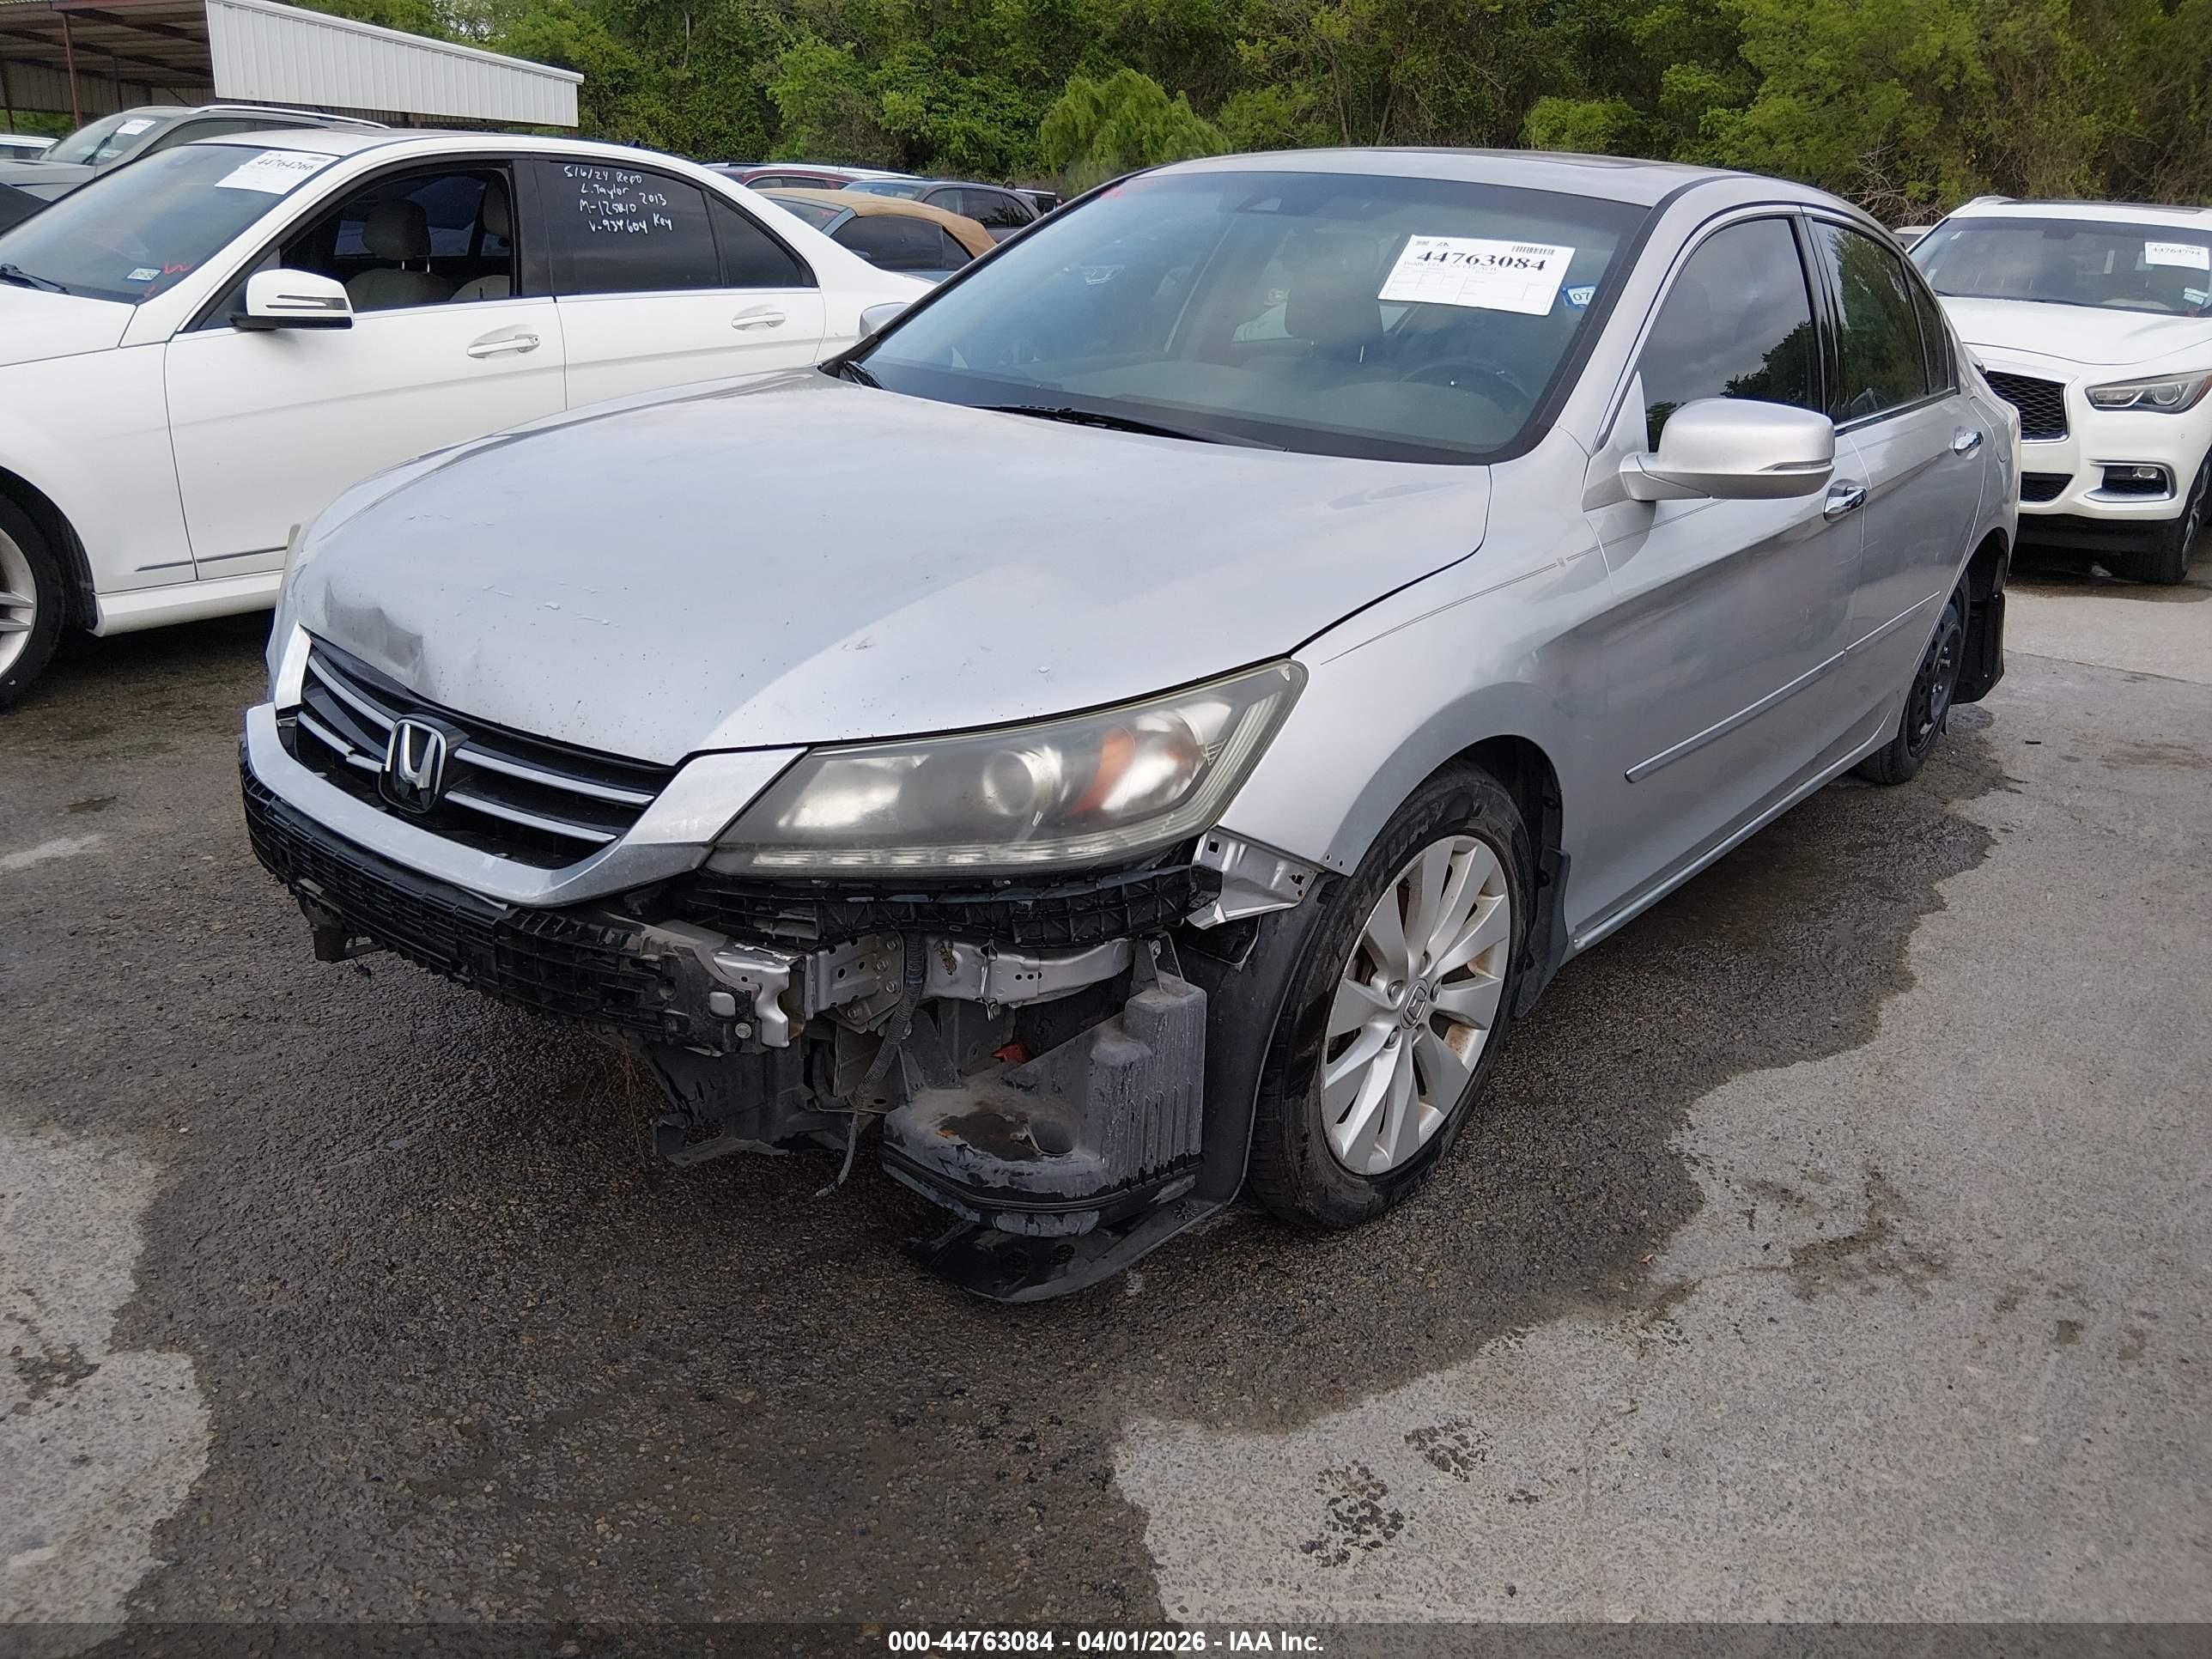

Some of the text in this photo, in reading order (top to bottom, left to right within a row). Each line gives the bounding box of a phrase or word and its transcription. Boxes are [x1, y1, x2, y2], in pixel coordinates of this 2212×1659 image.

[639, 192, 667, 206] 2013
[653, 213, 673, 231] Key
[1417, 250, 1546, 270] 44763084
[1572, 292, 1590, 301] 07
